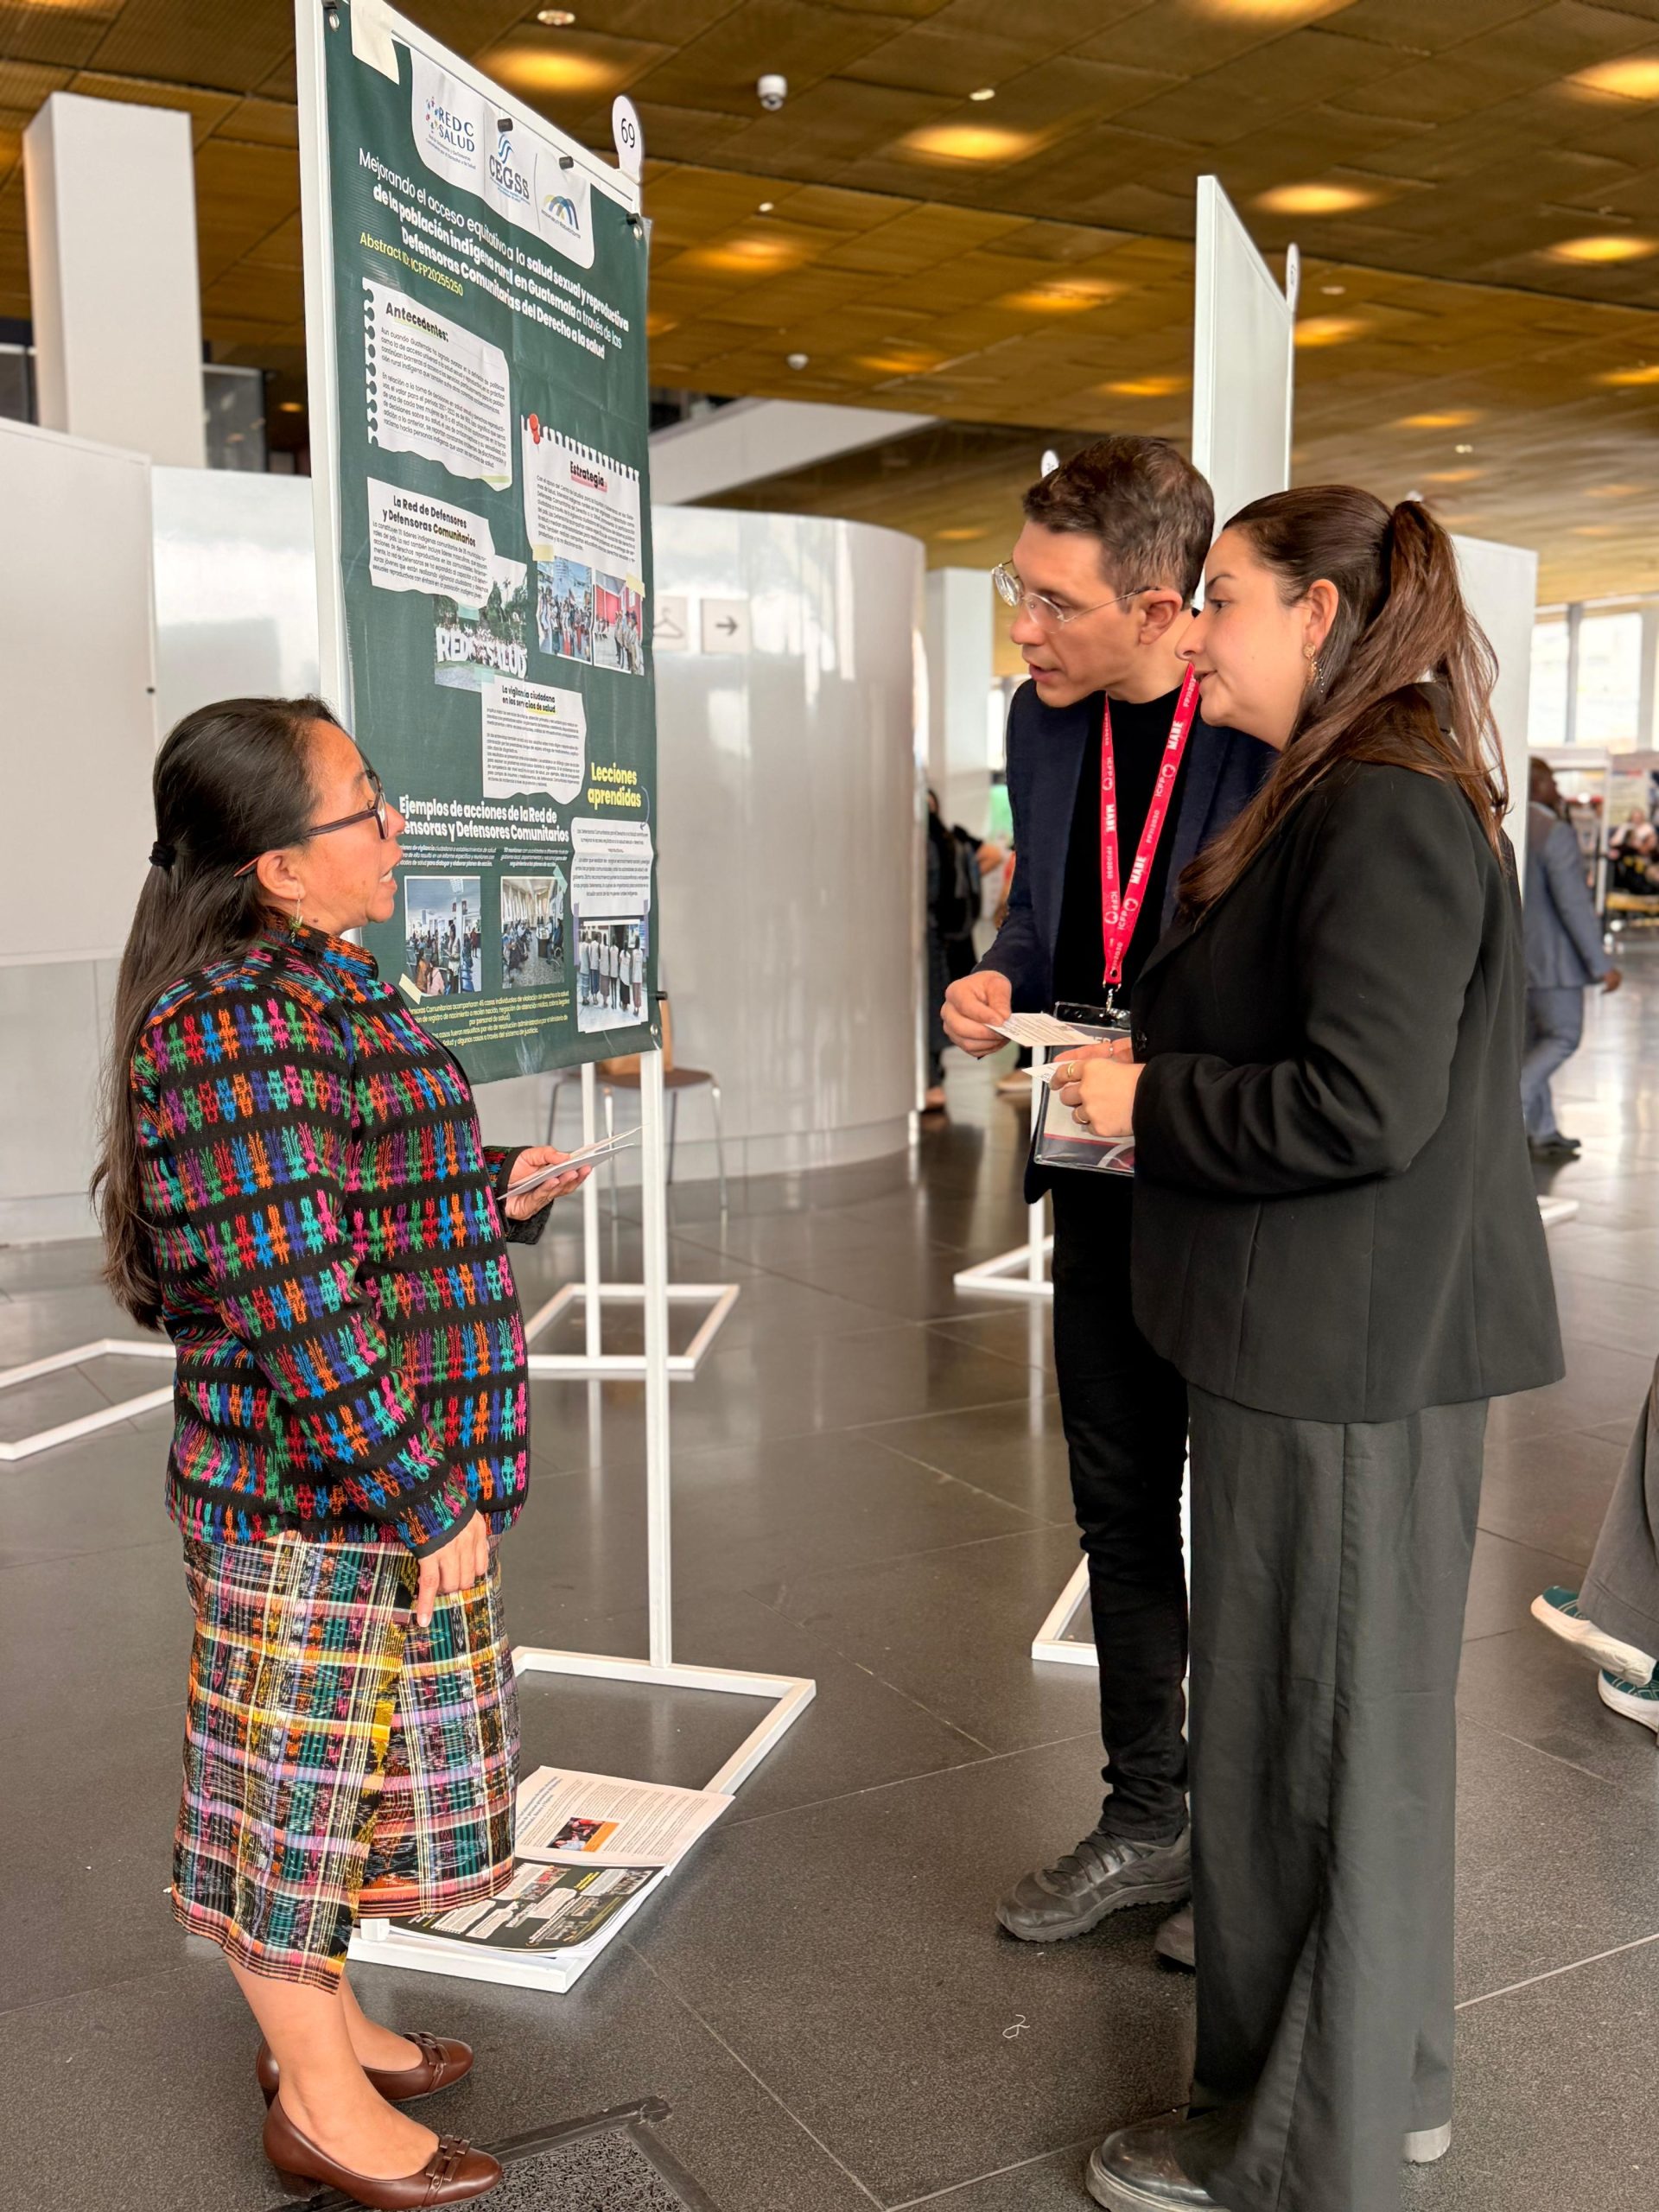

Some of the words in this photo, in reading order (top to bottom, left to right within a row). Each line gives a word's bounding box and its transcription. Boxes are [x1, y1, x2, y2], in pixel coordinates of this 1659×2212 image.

[439, 124, 474, 152] SALUD
[621, 118, 635, 149] 69
[489, 154, 530, 200] CEGSS
[359, 148, 416, 198] Mejorando
[416, 188, 427, 206] el
[428, 197, 465, 227] acceso
[467, 220, 507, 256] equitativo
[507, 248, 514, 261] a
[516, 246, 525, 265] la
[527, 257, 553, 282] salud
[553, 271, 581, 298] sexual
[581, 289, 587, 306] y
[587, 291, 629, 332] reproductiva
[360, 232, 402, 260] Abstract
[373, 184, 388, 206] de
[389, 190, 398, 213] la
[399, 201, 449, 245] población
[450, 229, 493, 267] indígena
[494, 257, 512, 285] rural
[514, 274, 527, 289] en
[528, 278, 576, 319] Guatemala
[576, 309, 582, 322] a
[582, 309, 603, 337] través
[603, 326, 612, 342] de
[612, 329, 622, 349] las
[402, 226, 460, 275] Defensoras
[461, 262, 520, 312] Comunitarias
[522, 299, 537, 319] del
[537, 306, 571, 339] Derecho
[572, 331, 577, 344] a
[577, 329, 586, 347] la
[586, 340, 605, 359] salud
[386, 302, 448, 342] Antecedentes:
[394, 494, 401, 508] La
[403, 498, 418, 513] Red
[420, 502, 429, 517] de
[430, 505, 467, 529] Defensores
[383, 509, 387, 523] y
[389, 510, 432, 532] Defensoras
[434, 523, 475, 547] Comunitarios
[502, 685, 508, 694] La
[531, 691, 555, 702] ciudadana
[543, 704, 556, 713] salud
[591, 762, 637, 785] Lecciones
[1154, 775, 1166, 797] ICFP
[399, 794, 448, 821] Ejemplos
[449, 800, 463, 817] de
[464, 801, 508, 821] acciones
[509, 804, 519, 821] de
[519, 805, 528, 822] la
[528, 807, 545, 823] Red
[546, 809, 557, 823] de
[588, 786, 641, 810] aprendidas
[403, 821, 448, 836] ensoras
[448, 823, 455, 842] y
[456, 820, 510, 839] Defensores
[511, 823, 569, 842] Comunitarios
[1117, 909, 1128, 931] ICFP
